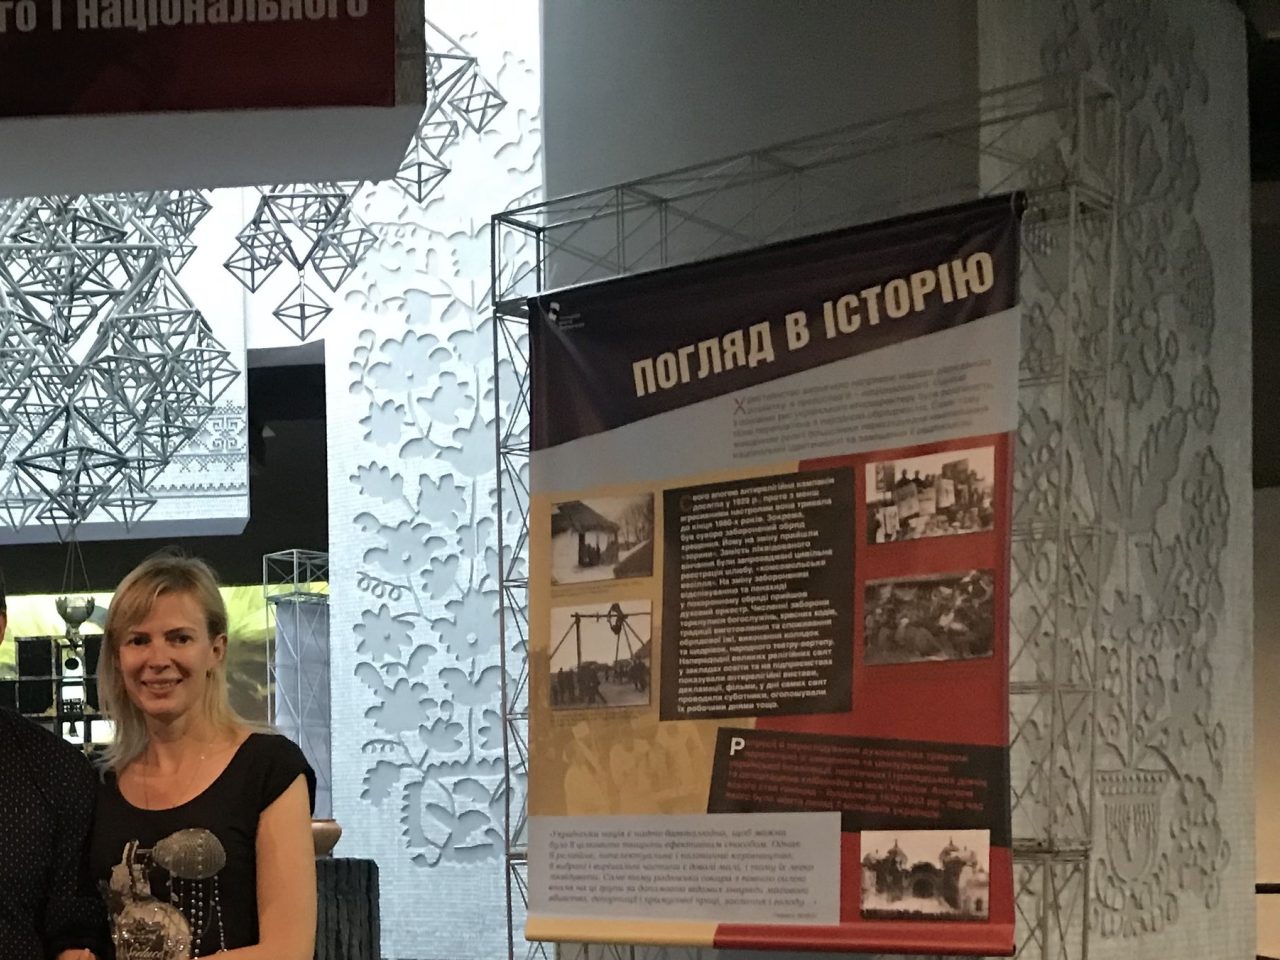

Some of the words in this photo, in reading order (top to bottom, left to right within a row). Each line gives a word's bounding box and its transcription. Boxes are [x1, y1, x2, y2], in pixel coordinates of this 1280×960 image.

[632, 320, 776, 398] ПОГЛЯД
[785, 310, 810, 351] В
[823, 251, 995, 340] ІСТОРІЮ
